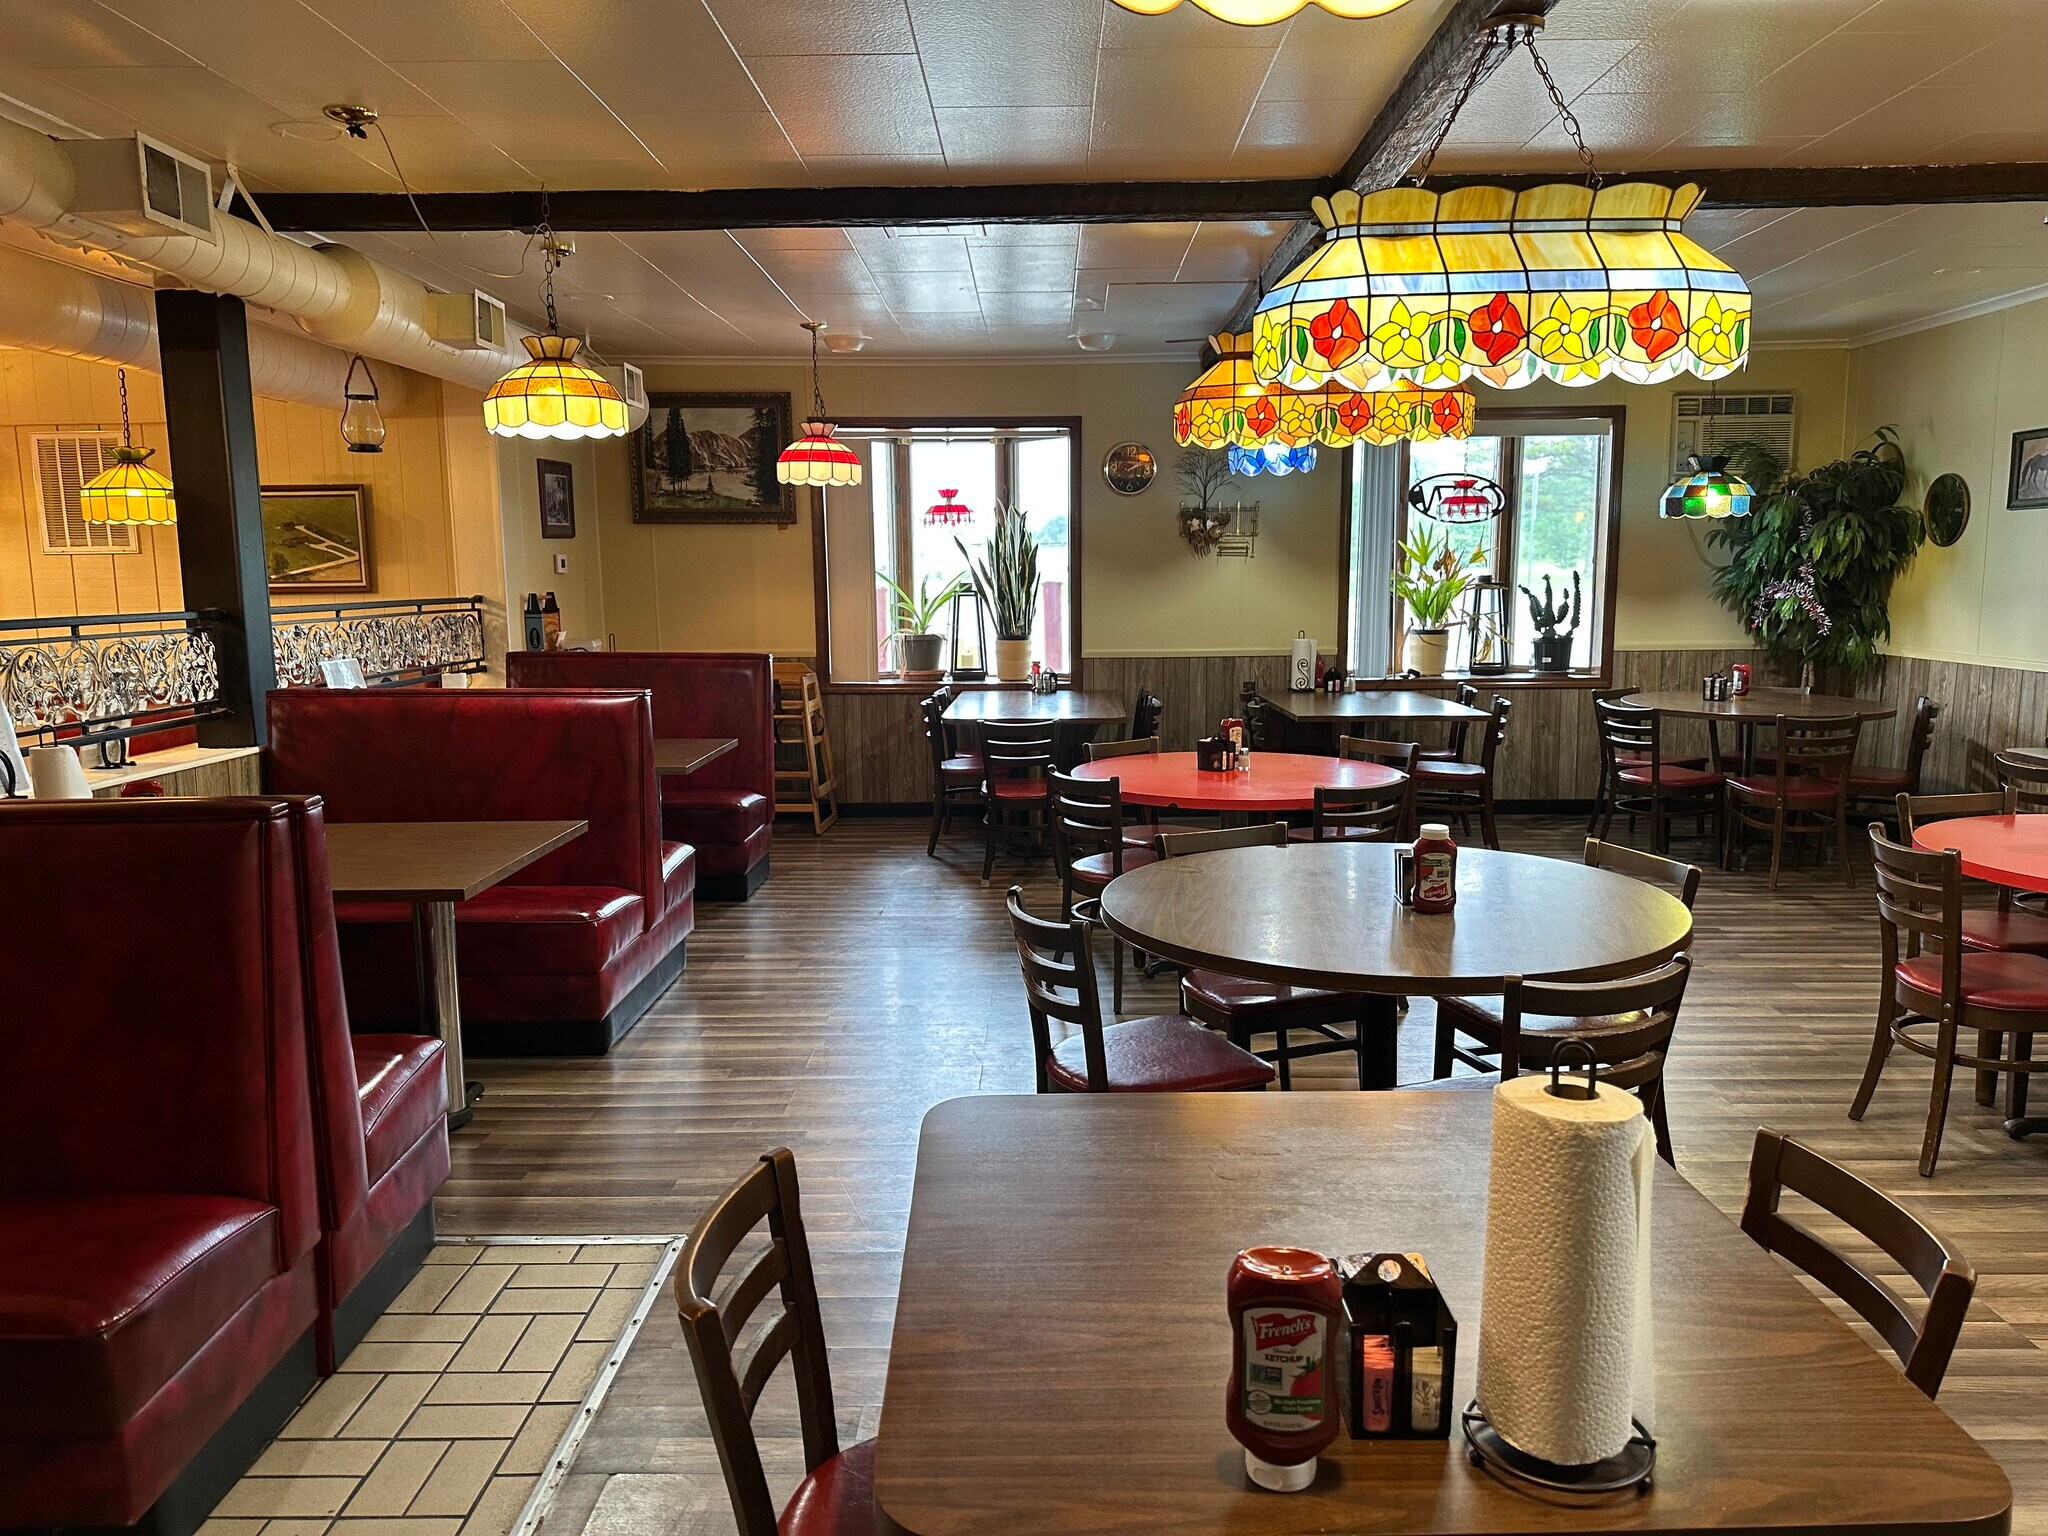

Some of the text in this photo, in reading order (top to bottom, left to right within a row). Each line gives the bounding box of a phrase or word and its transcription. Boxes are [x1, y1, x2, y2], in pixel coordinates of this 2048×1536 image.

[1126, 447, 1137, 457] 12
[1110, 464, 1117, 473] 9
[1143, 465, 1150, 475] 3
[1126, 481, 1133, 491] 6
[1259, 1318, 1311, 1340] French's
[1265, 1354, 1304, 1363] KETCHUP
